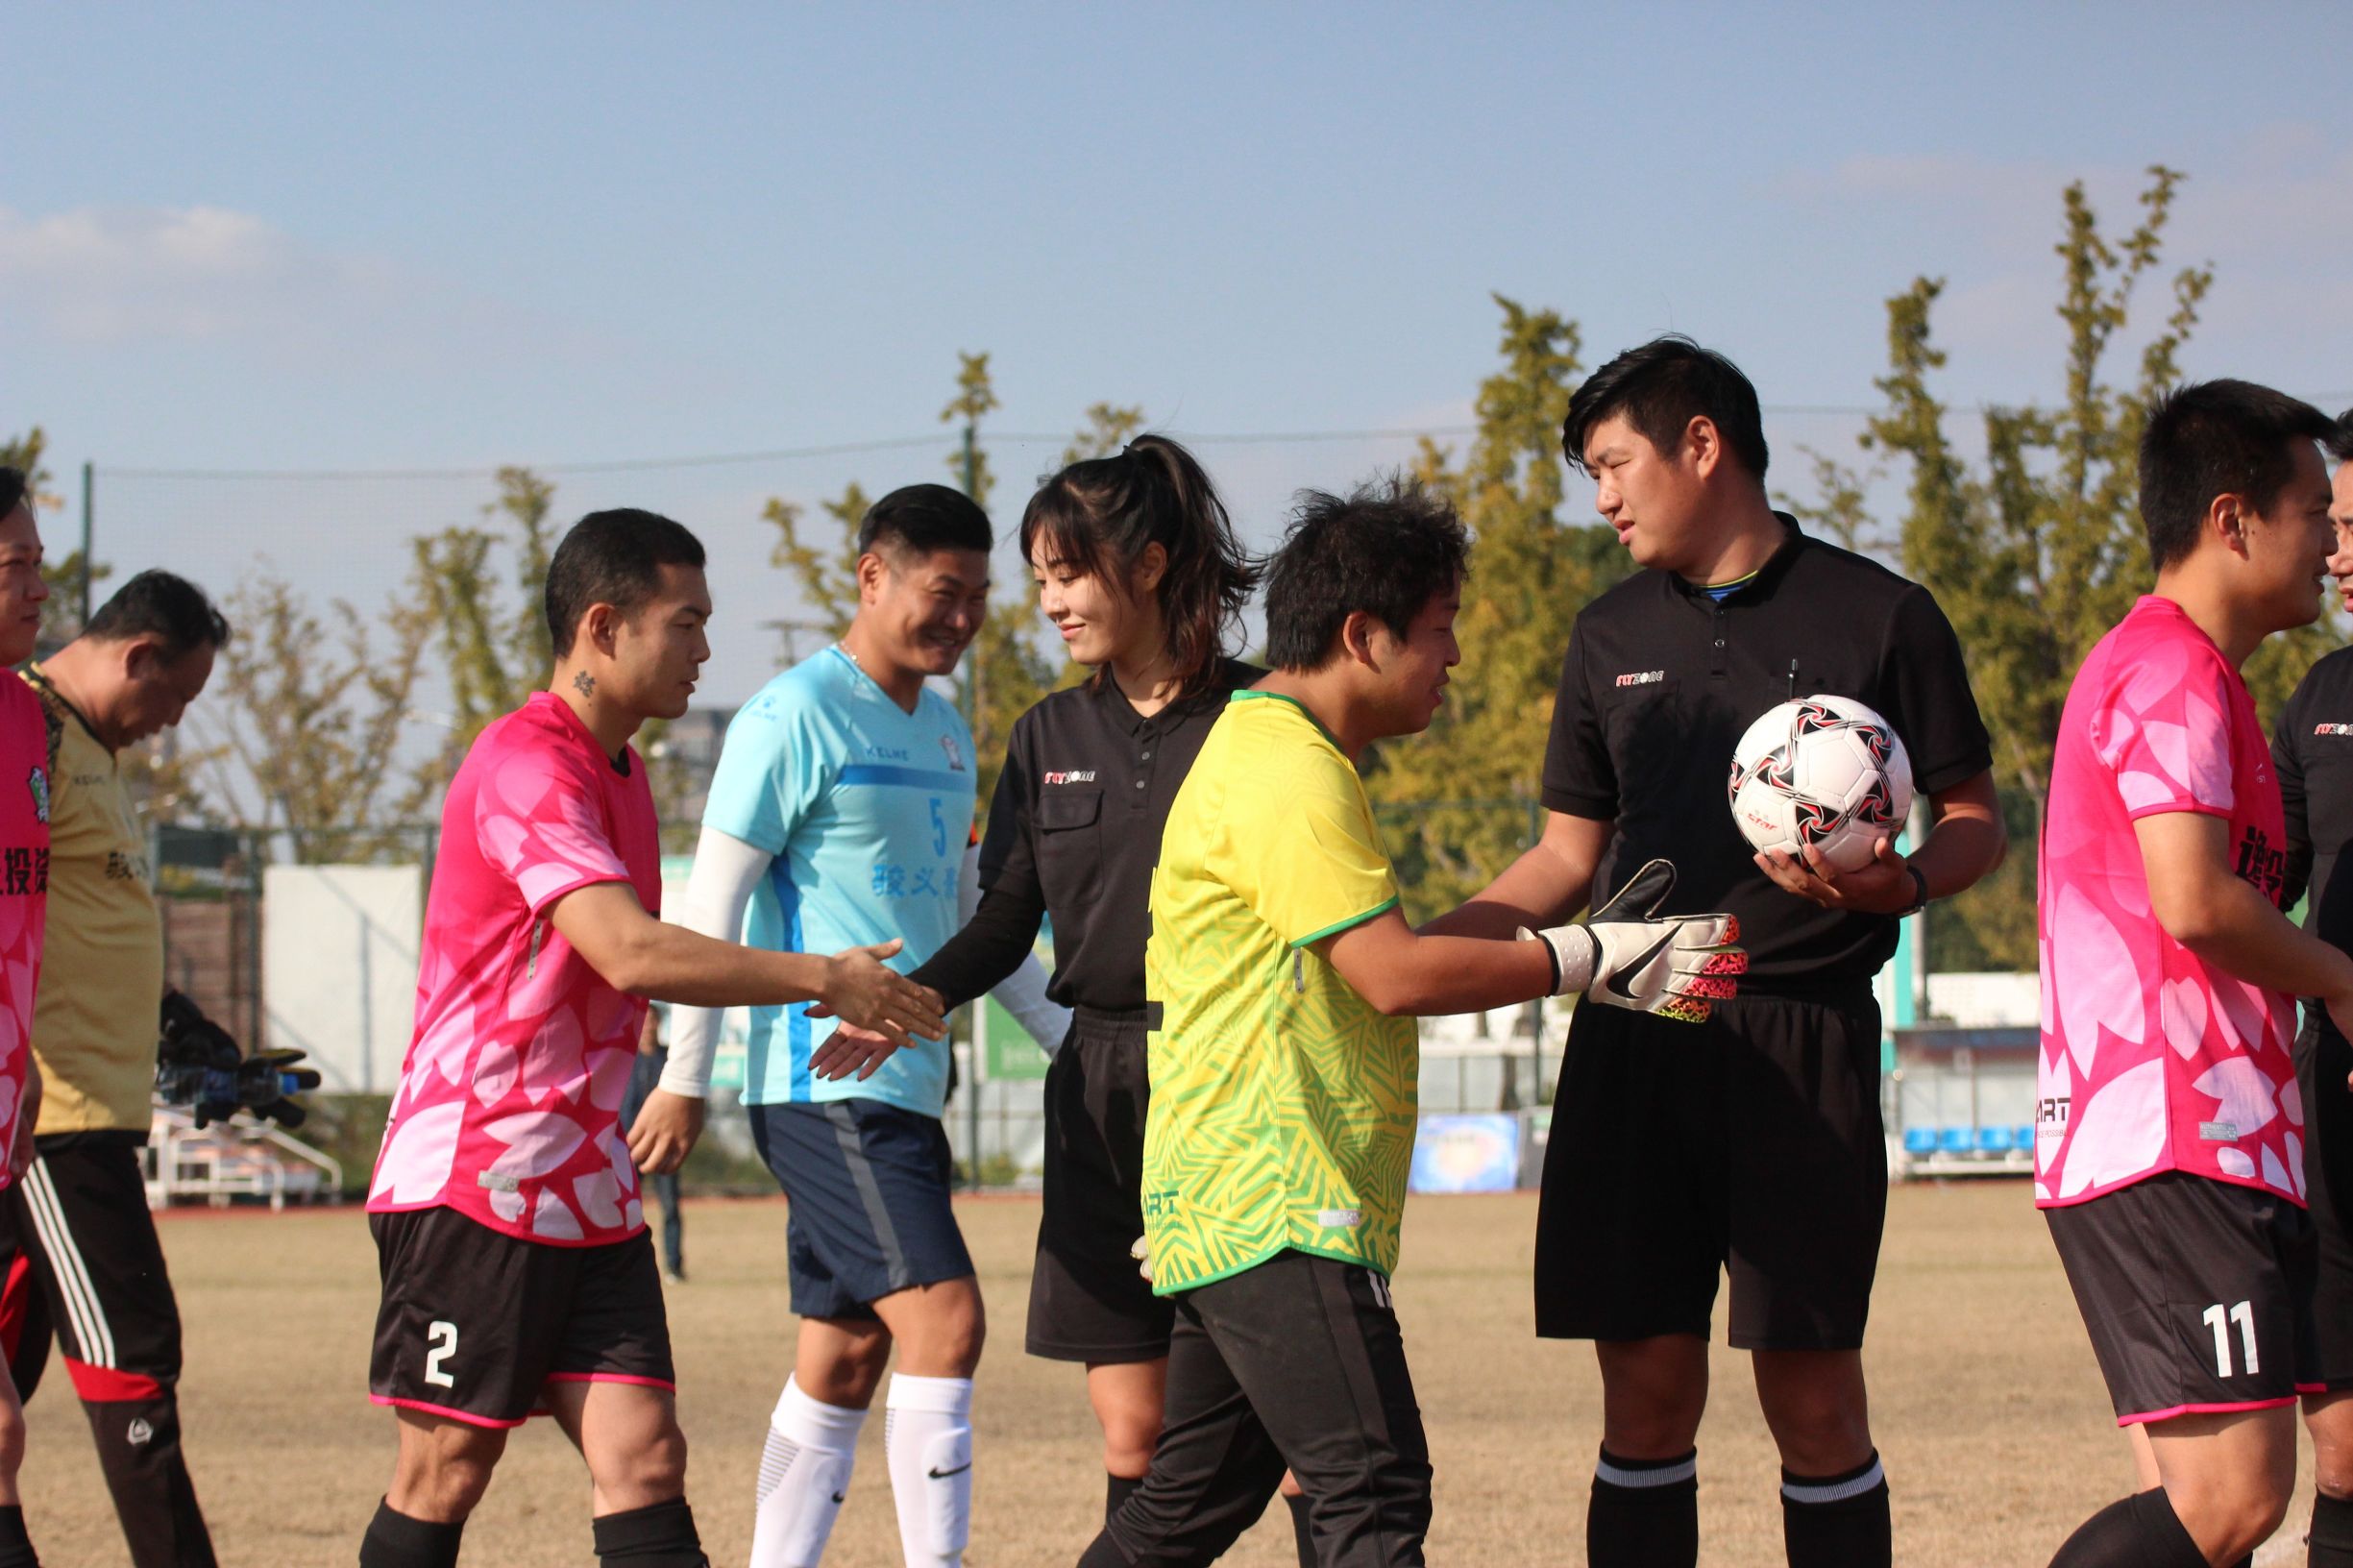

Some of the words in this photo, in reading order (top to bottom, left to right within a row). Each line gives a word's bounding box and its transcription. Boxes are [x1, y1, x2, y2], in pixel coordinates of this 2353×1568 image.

[929, 797, 946, 858] 5
[425, 1320, 457, 1388] 2
[2203, 1300, 2259, 1378] 11
